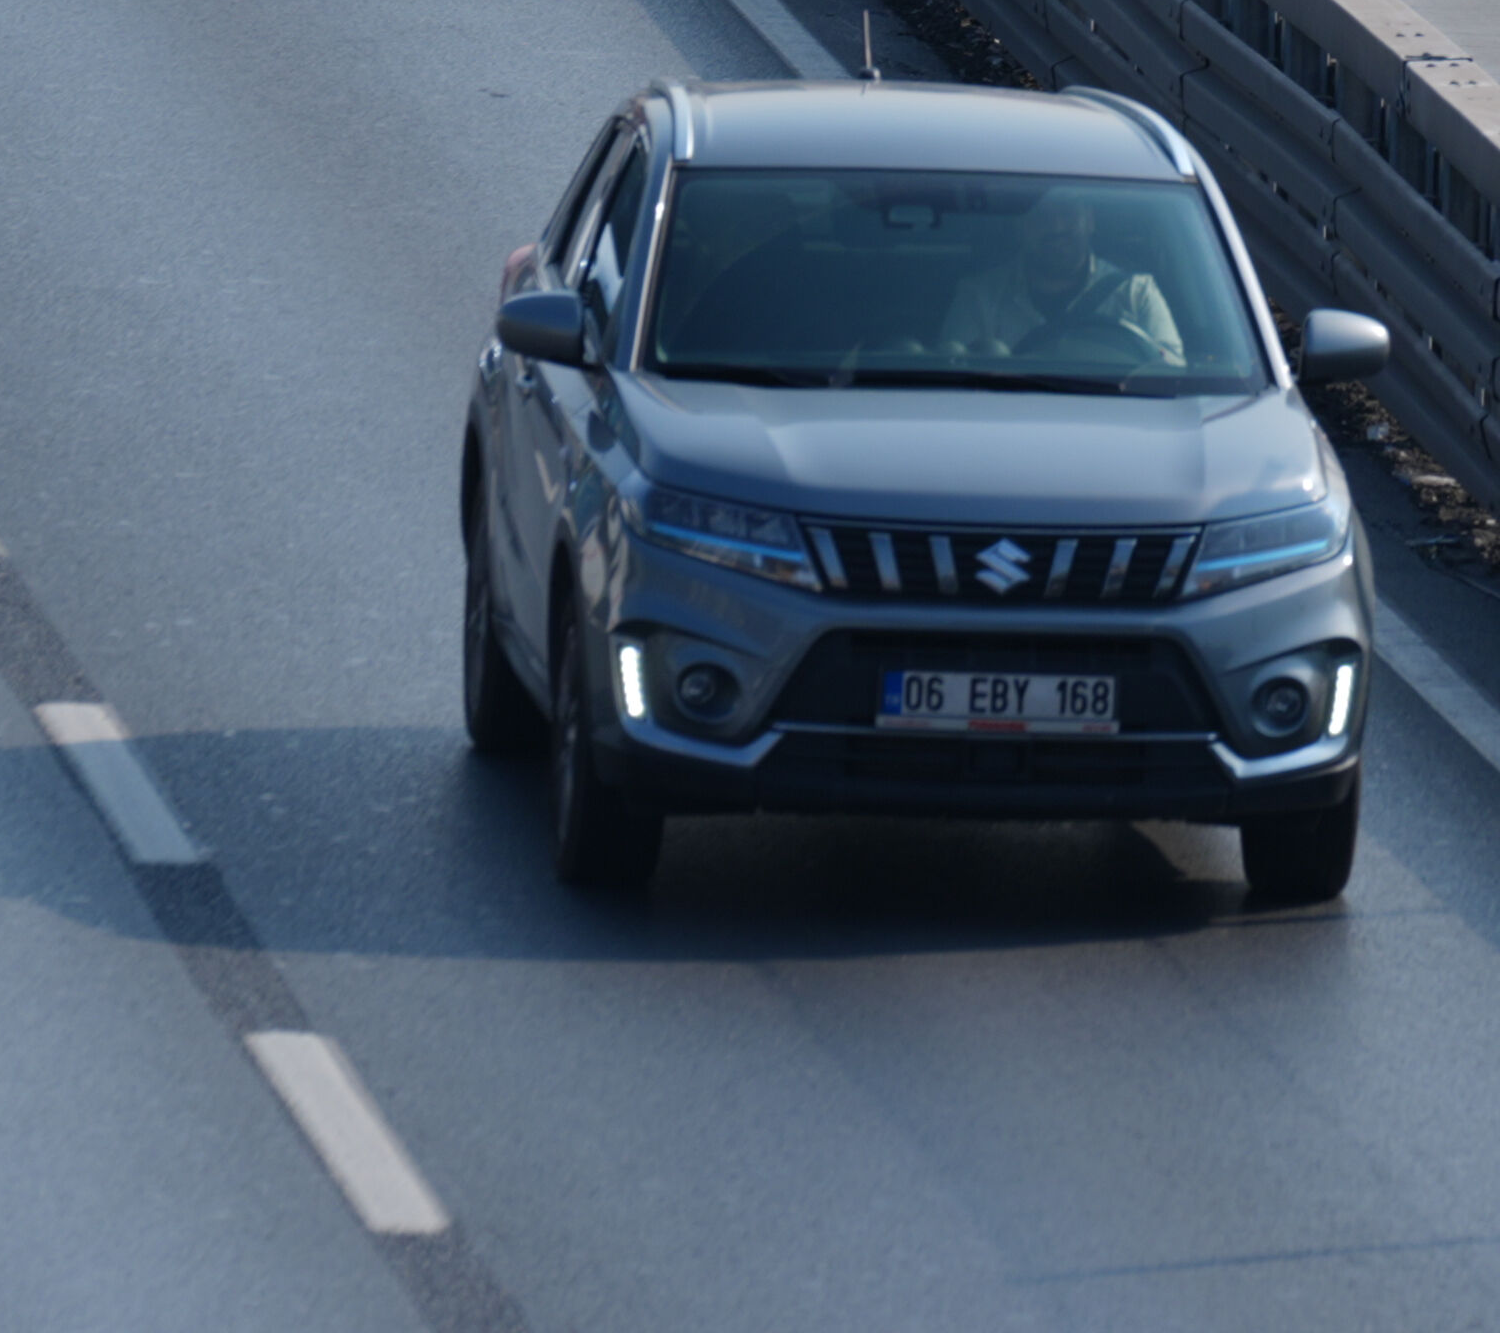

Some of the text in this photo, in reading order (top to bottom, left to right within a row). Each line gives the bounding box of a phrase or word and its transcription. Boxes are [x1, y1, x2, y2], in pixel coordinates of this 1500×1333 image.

[905, 676, 945, 712] 06
[969, 677, 1031, 715] EBY
[1056, 679, 1112, 716] 168
